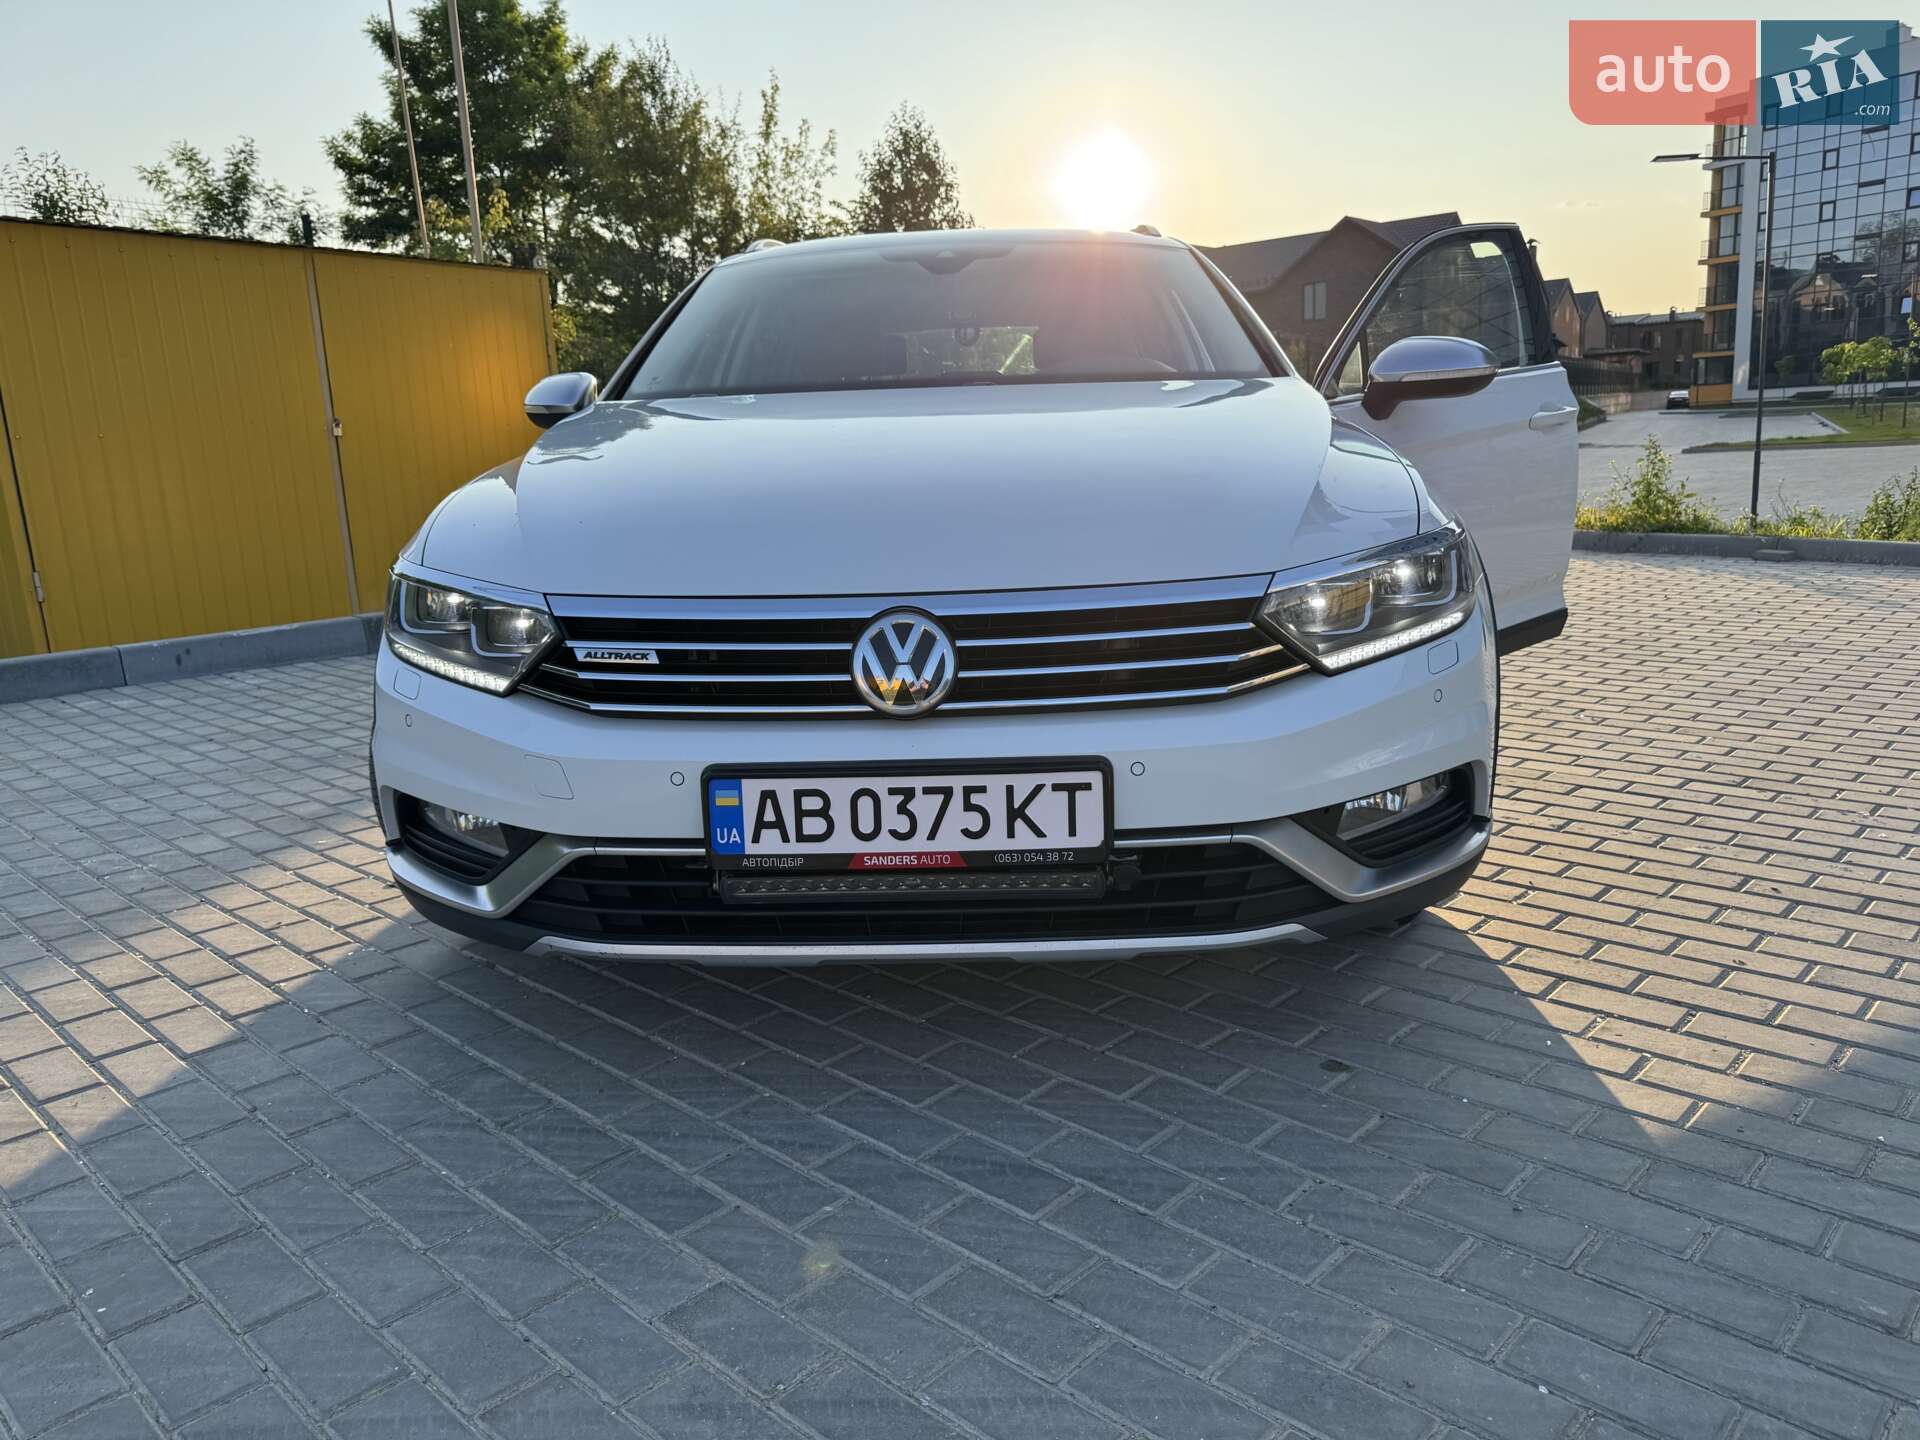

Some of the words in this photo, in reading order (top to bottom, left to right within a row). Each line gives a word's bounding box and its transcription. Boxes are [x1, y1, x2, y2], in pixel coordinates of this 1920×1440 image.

[583, 650, 651, 662] ALLTRACK
[751, 788, 836, 844] AB
[849, 784, 992, 842] 0375
[1005, 782, 1093, 839] KT
[716, 826, 742, 845] UA
[742, 857, 804, 869] АВТОПІДБІР
[863, 855, 918, 866] SANDERS
[920, 854, 951, 865] AUTO
[994, 853, 1022, 863] (063)
[1023, 852, 1043, 862] 054
[1046, 851, 1059, 862] 38
[1061, 851, 1074, 861] 72
